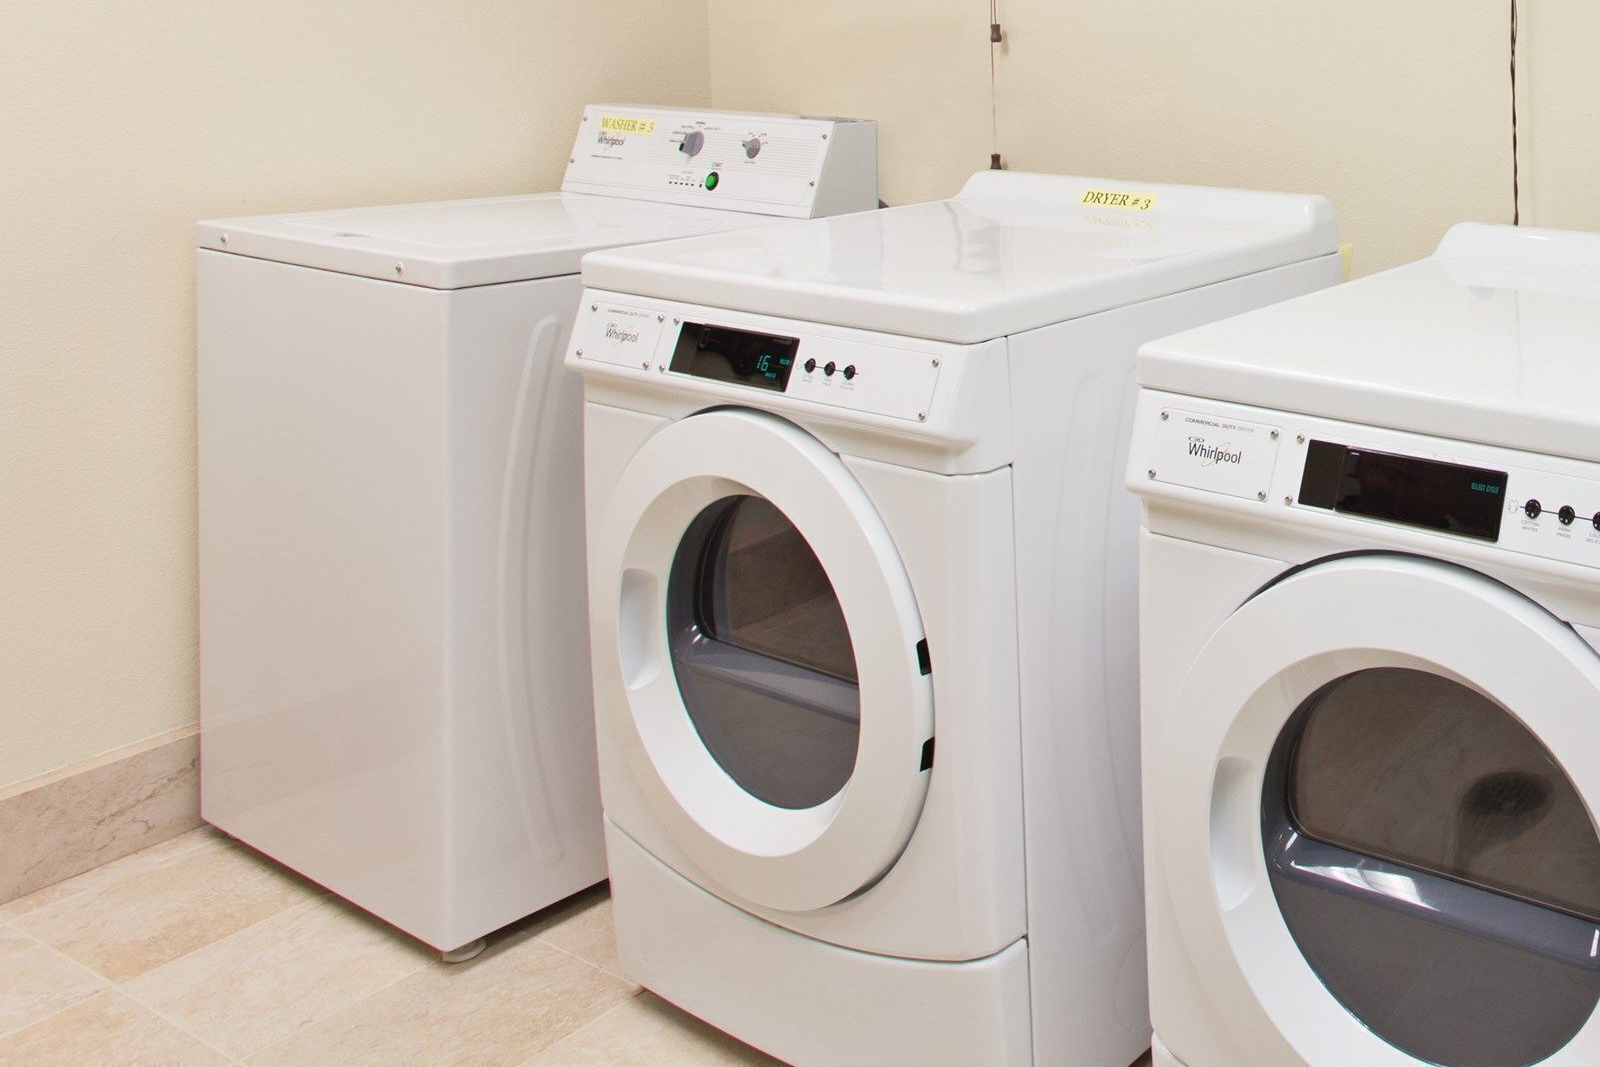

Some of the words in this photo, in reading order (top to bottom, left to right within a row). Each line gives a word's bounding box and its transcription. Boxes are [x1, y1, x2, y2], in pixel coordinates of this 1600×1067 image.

[601, 118, 638, 132] WASHER
[1083, 191, 1130, 206] DRYER
[1140, 199, 1151, 211] 3
[606, 327, 640, 343] Whirlpool
[1185, 417, 1220, 428] COMMERCIAL
[1222, 423, 1237, 431] DUTY
[1188, 442, 1242, 465] Whirlpool
